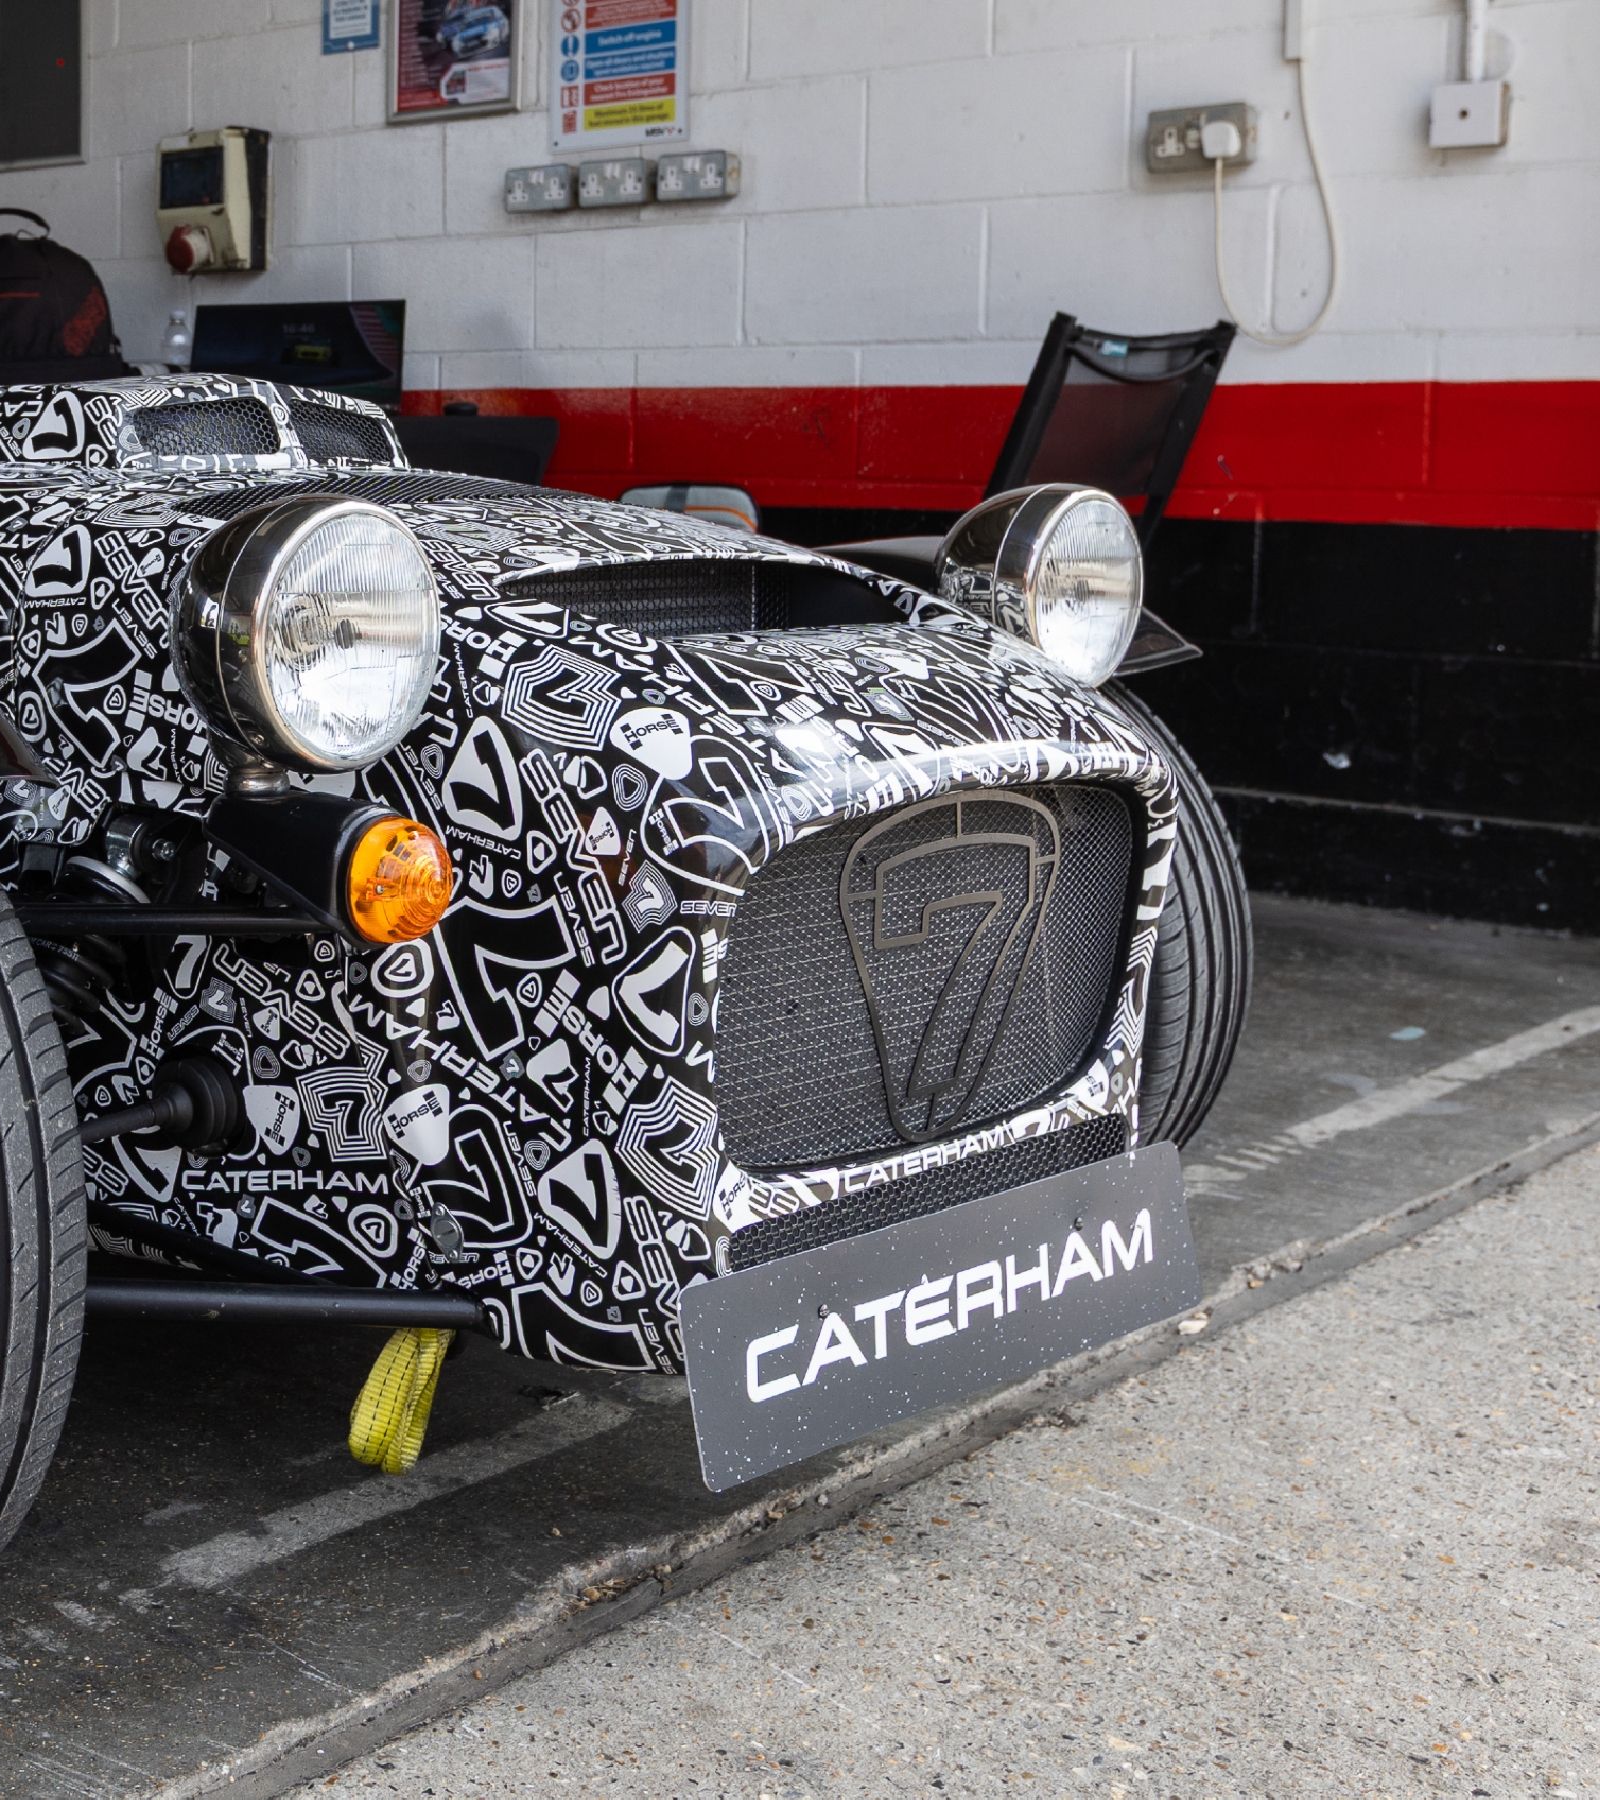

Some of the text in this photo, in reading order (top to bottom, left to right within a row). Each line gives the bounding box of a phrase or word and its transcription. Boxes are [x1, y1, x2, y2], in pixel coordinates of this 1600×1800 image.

[113, 598, 158, 659] SEVEN
[623, 717, 681, 744] HORSE
[446, 825, 522, 861] CATERHAM
[519, 748, 628, 966] SEVEN
[553, 872, 596, 968] SEVEN
[680, 900, 738, 918] SEVEN
[213, 943, 350, 1060] SEVEN
[349, 994, 573, 1152] CATERHAM
[542, 986, 639, 1100] HORSE
[390, 1095, 442, 1134] HORSE
[181, 1169, 389, 1195] CATERHAM
[503, 1121, 536, 1198] SEVEN
[844, 1125, 1005, 1193] CATERHAM
[534, 1213, 607, 1279] CATERHAM
[746, 1206, 1155, 1405] CATERHAM
